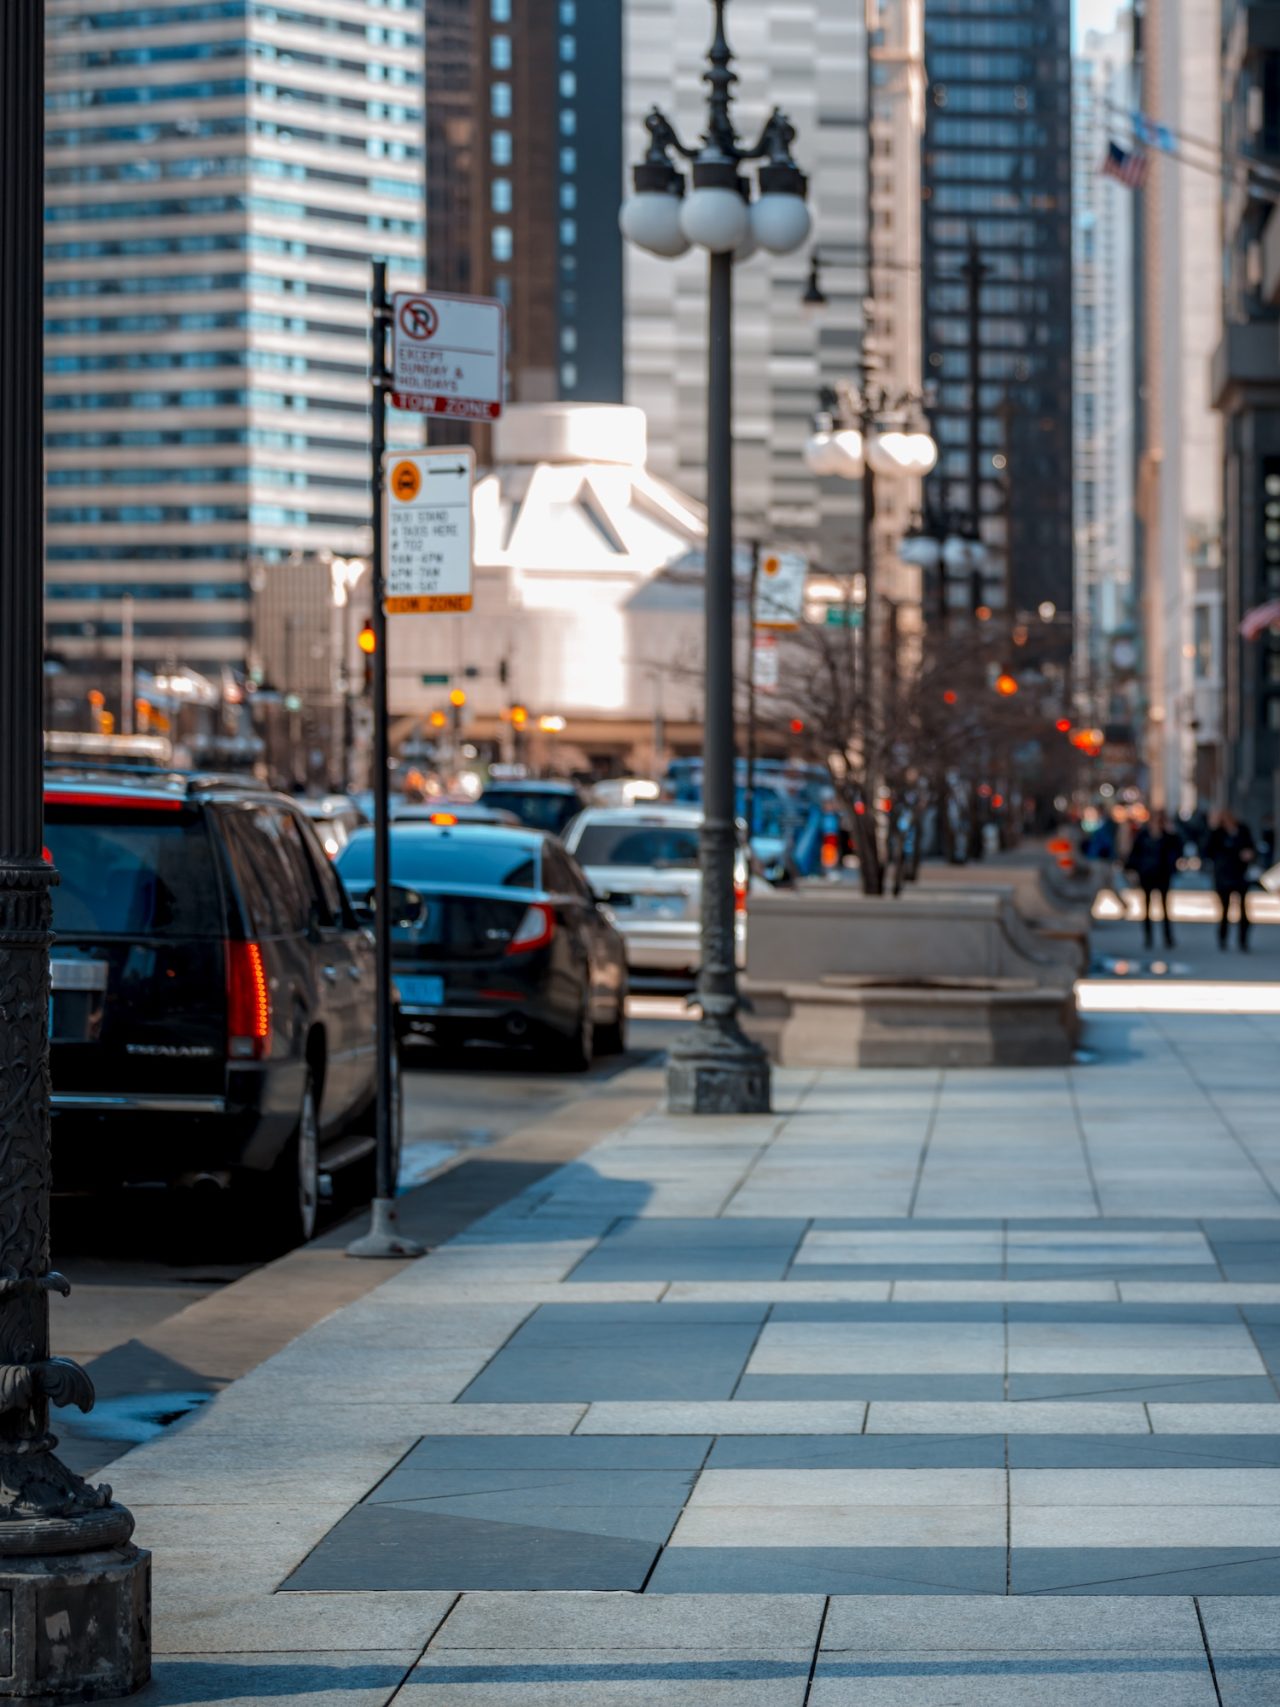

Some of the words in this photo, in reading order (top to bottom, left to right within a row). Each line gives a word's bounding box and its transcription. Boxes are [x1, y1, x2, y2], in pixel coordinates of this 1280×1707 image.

[400, 347, 443, 362] EXCEPT
[400, 362, 448, 375] SUNDAY
[455, 367, 464, 379] &
[400, 376, 458, 392] HOLIDAYS
[399, 394, 436, 411] TOW
[447, 399, 491, 416] ZONE
[392, 512, 413, 523] TAXI
[418, 511, 448, 523] STAND
[402, 526, 428, 537] TAXIS
[433, 524, 458, 536] HERE
[391, 597, 419, 611] TOW
[429, 595, 464, 610] ZONE
